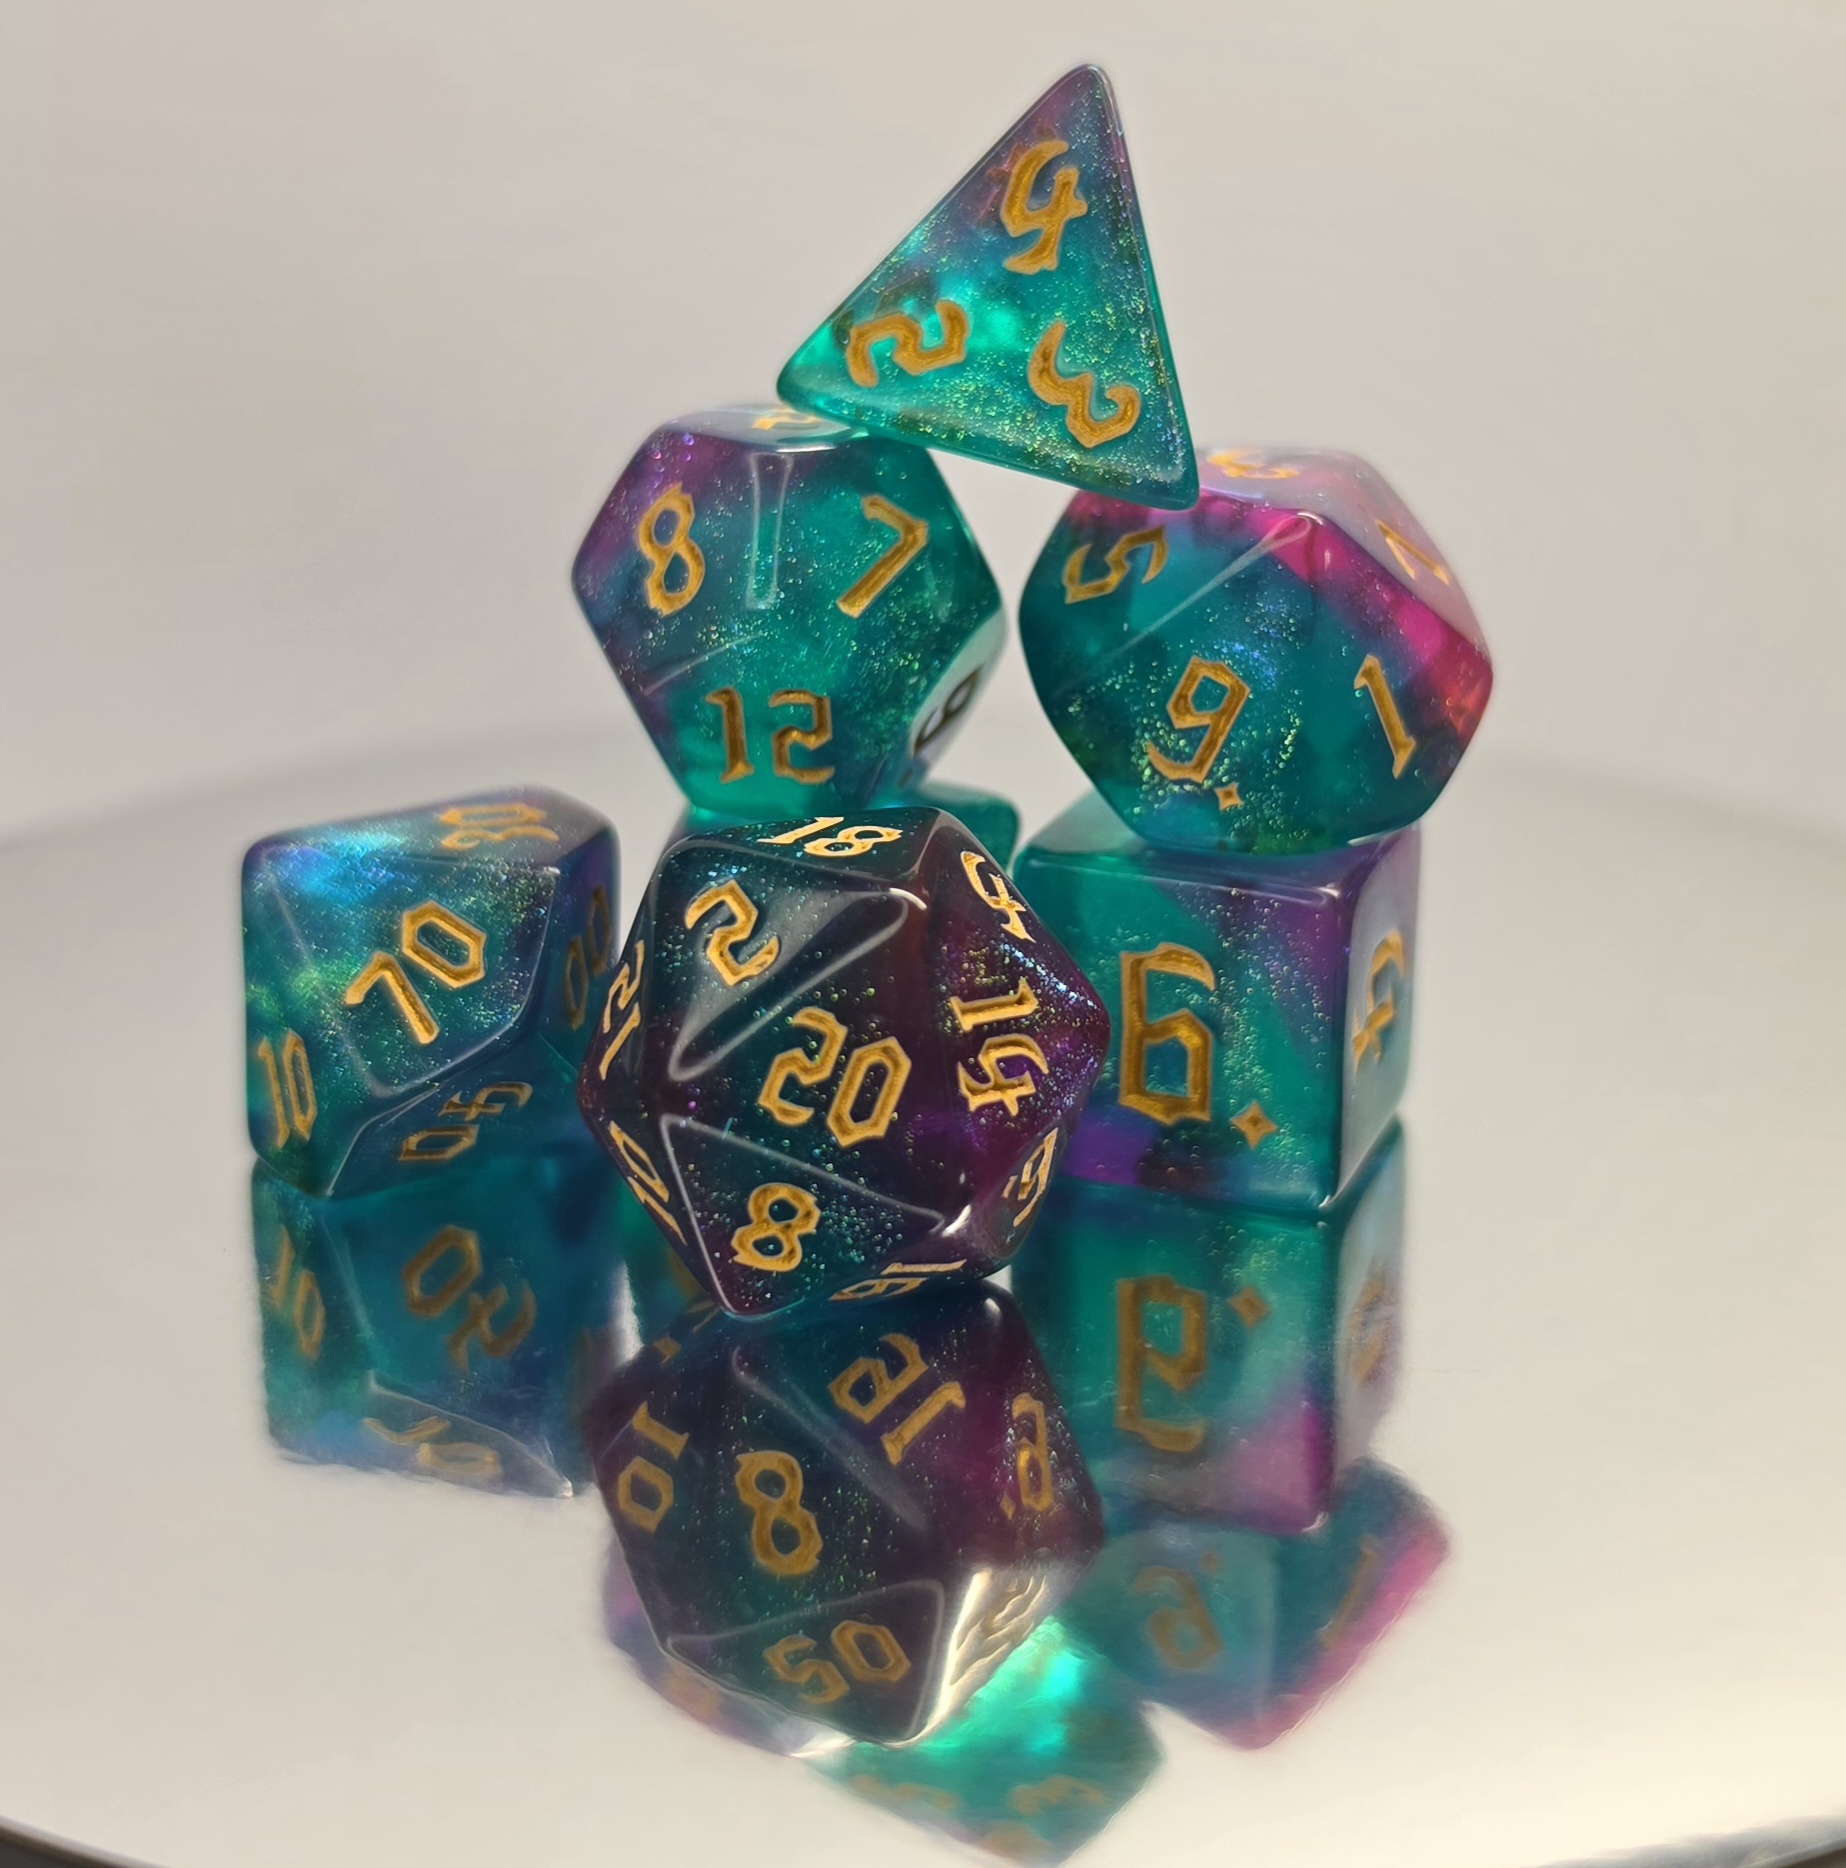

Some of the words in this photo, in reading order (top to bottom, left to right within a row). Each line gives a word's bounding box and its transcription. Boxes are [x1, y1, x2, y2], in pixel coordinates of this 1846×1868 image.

[1001, 140, 1089, 274] 4
[1027, 320, 1142, 448] 3
[636, 482, 706, 618] 8
[836, 493, 930, 618] 7
[704, 686, 835, 784] 12
[1354, 654, 1416, 780] 1
[756, 816, 904, 857] 18
[960, 851, 1037, 944] 4
[345, 900, 488, 1045] 70
[684, 879, 781, 987] 2
[257, 1028, 318, 1150] 10
[758, 1006, 912, 1148] 20
[950, 980, 1049, 1118] 14
[730, 1182, 821, 1272] 8
